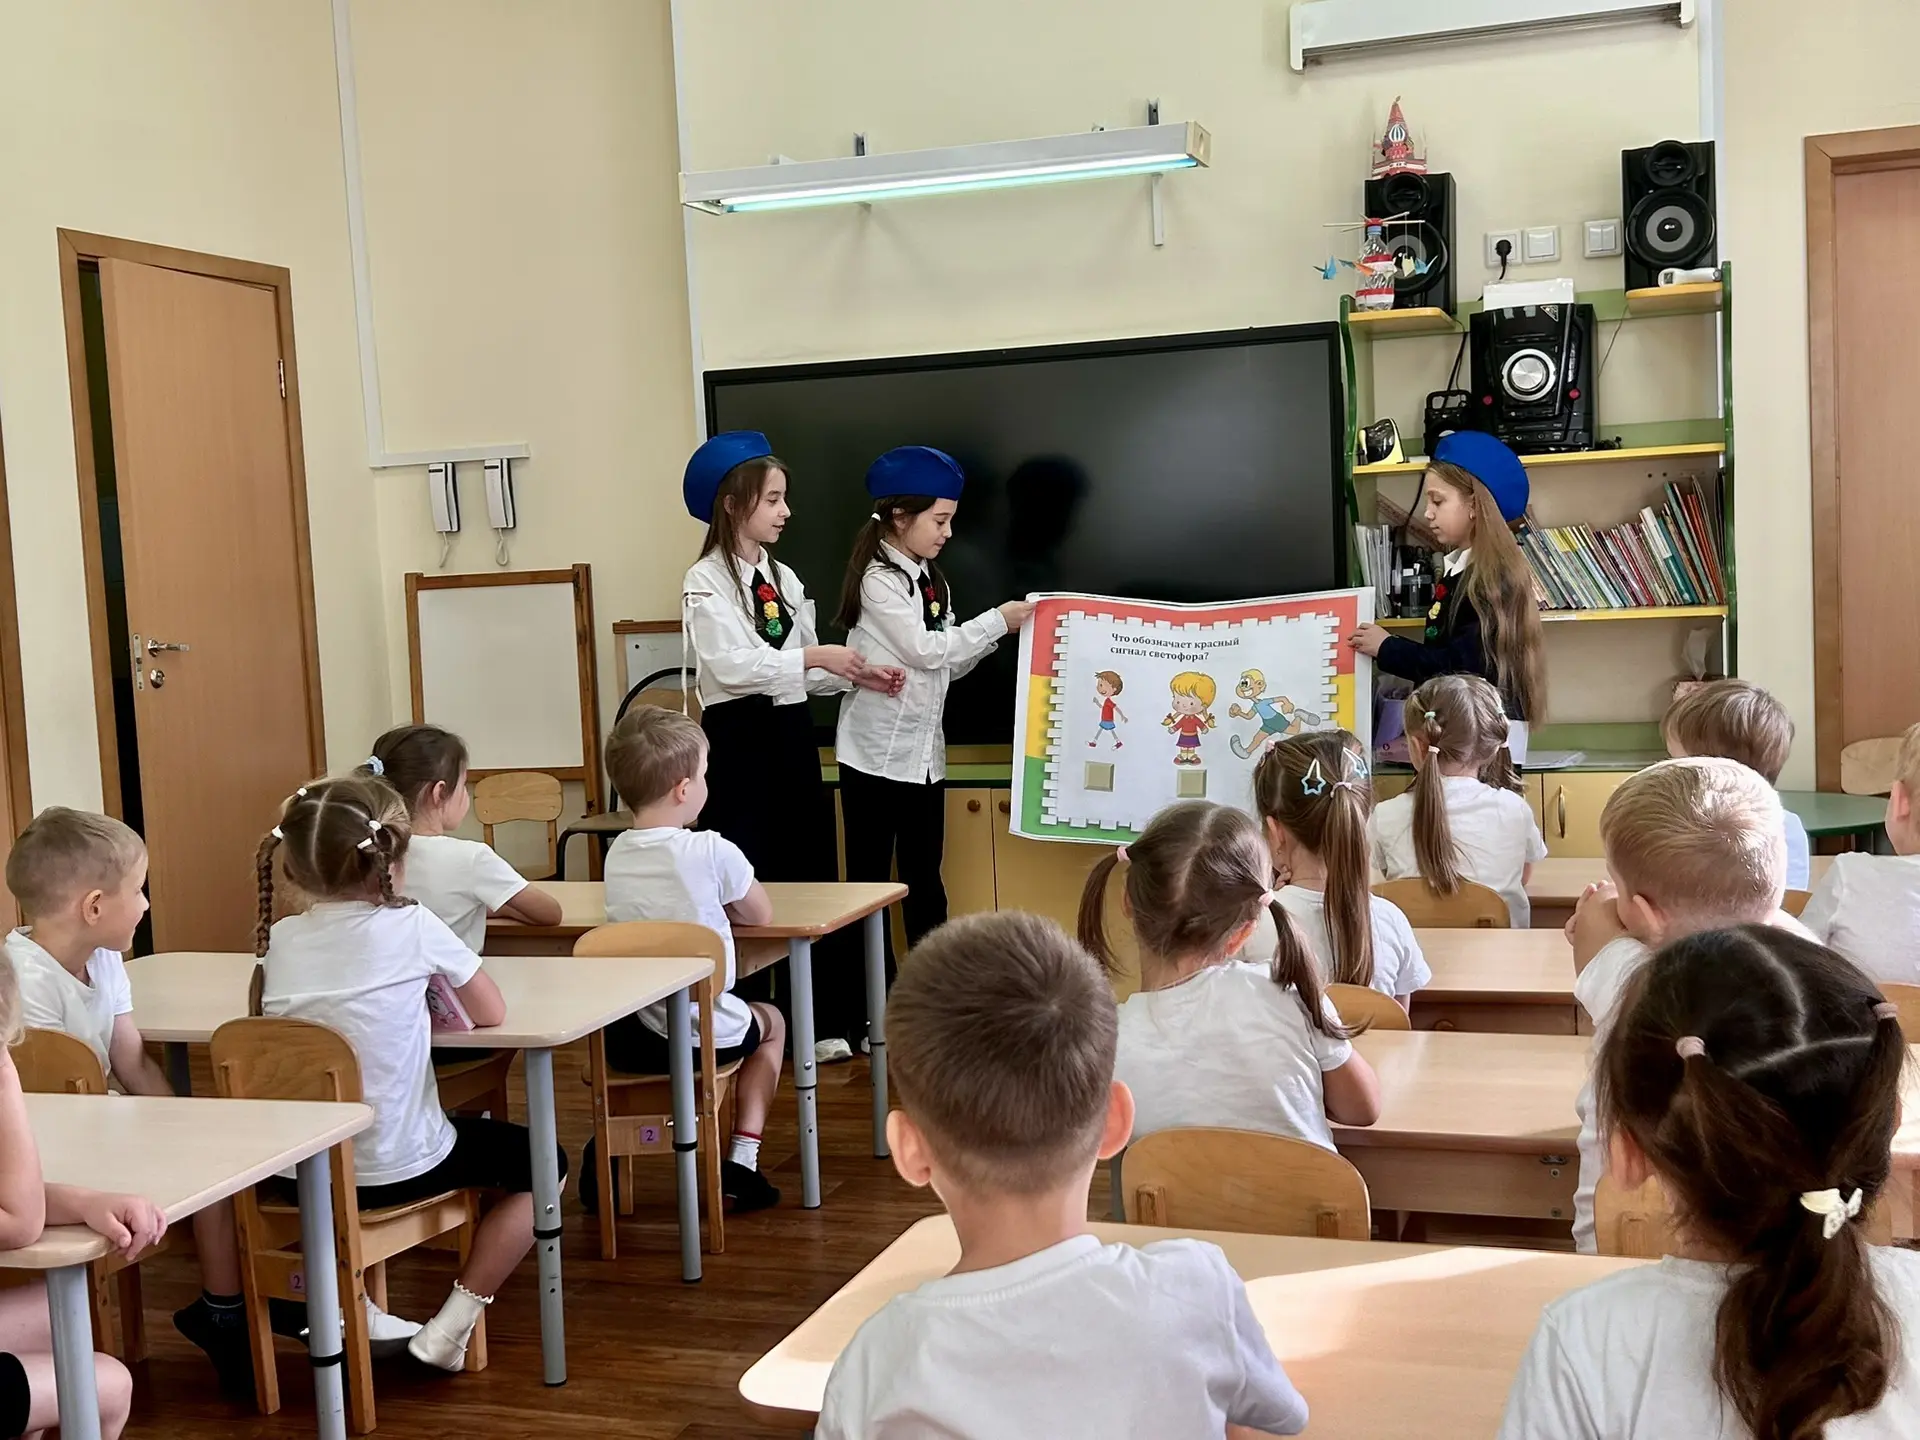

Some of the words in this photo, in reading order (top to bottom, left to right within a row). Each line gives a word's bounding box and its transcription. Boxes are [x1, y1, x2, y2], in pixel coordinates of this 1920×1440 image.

[1111, 633, 1131, 643] Что
[1132, 636, 1192, 649] обозначает
[1194, 637, 1240, 650] красный
[1110, 646, 1147, 657] сигнал
[1148, 651, 1210, 662] светофора?
[646, 1129, 654, 1141] 2
[293, 1275, 302, 1289] 2
